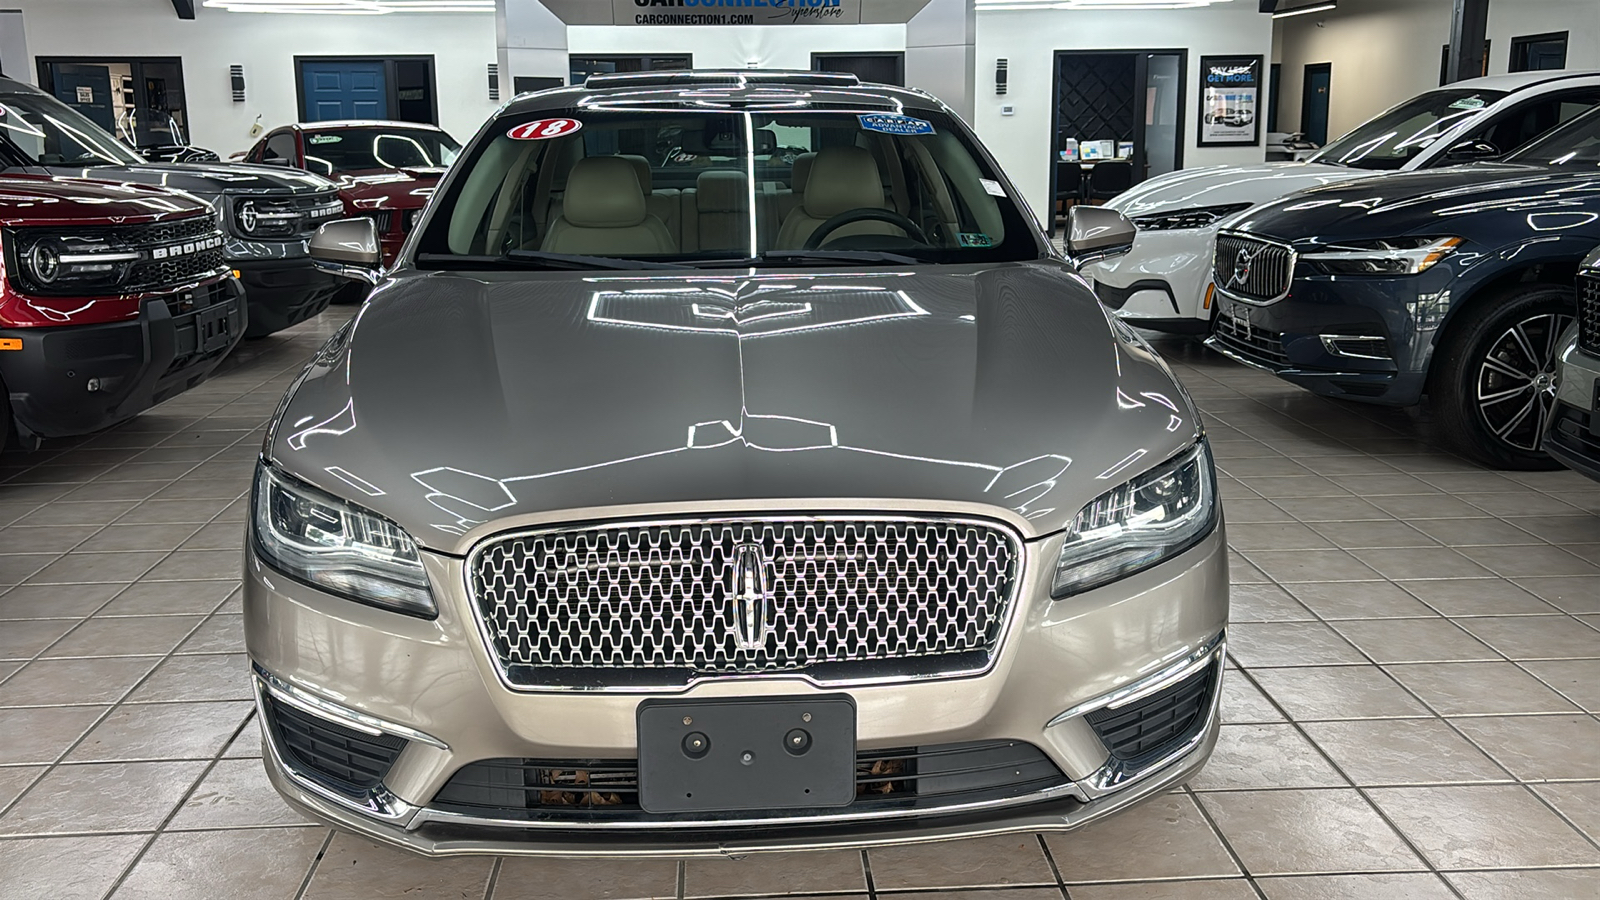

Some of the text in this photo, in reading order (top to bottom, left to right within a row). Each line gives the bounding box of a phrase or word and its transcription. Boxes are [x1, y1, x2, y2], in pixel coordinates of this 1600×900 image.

[768, 0, 843, 23] Superstore
[635, 14, 753, 25] CARCONNECTION1.COM
[1207, 74, 1224, 82] GET
[521, 120, 568, 138] 18
[872, 122, 924, 131] ADVANTAGE
[153, 236, 222, 260] BRONCO
